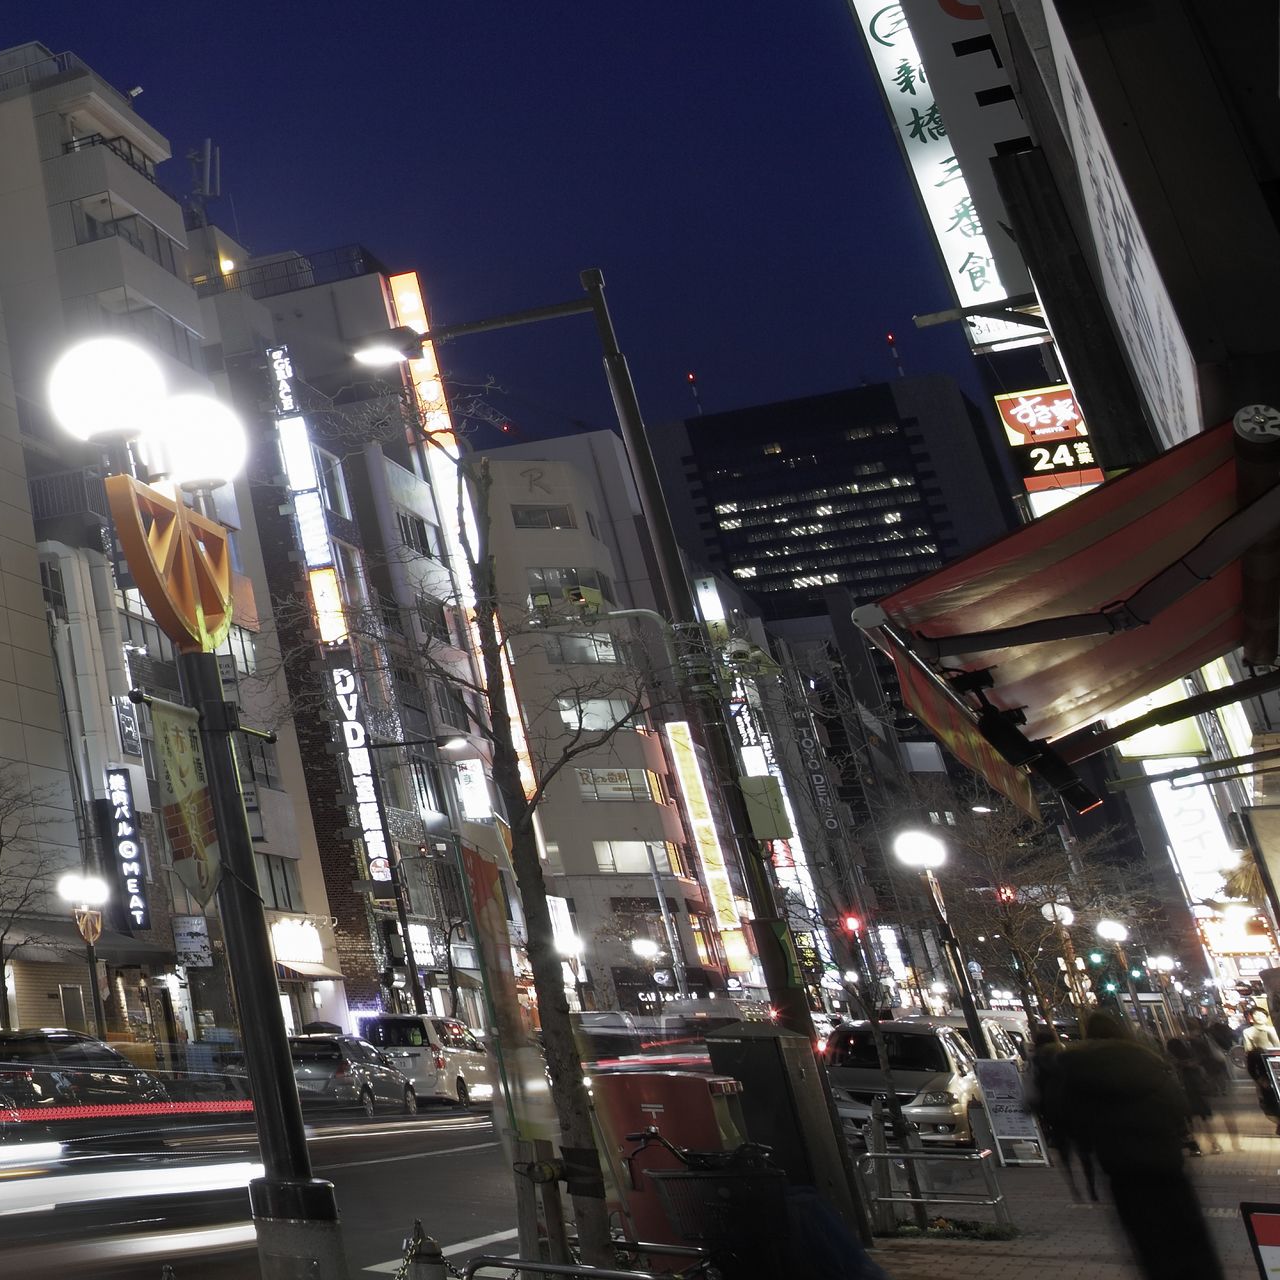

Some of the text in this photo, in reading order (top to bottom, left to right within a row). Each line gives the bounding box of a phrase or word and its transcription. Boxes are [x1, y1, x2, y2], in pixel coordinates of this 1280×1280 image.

[1009, 396, 1080, 427] すき家
[1030, 444, 1074, 471] 24
